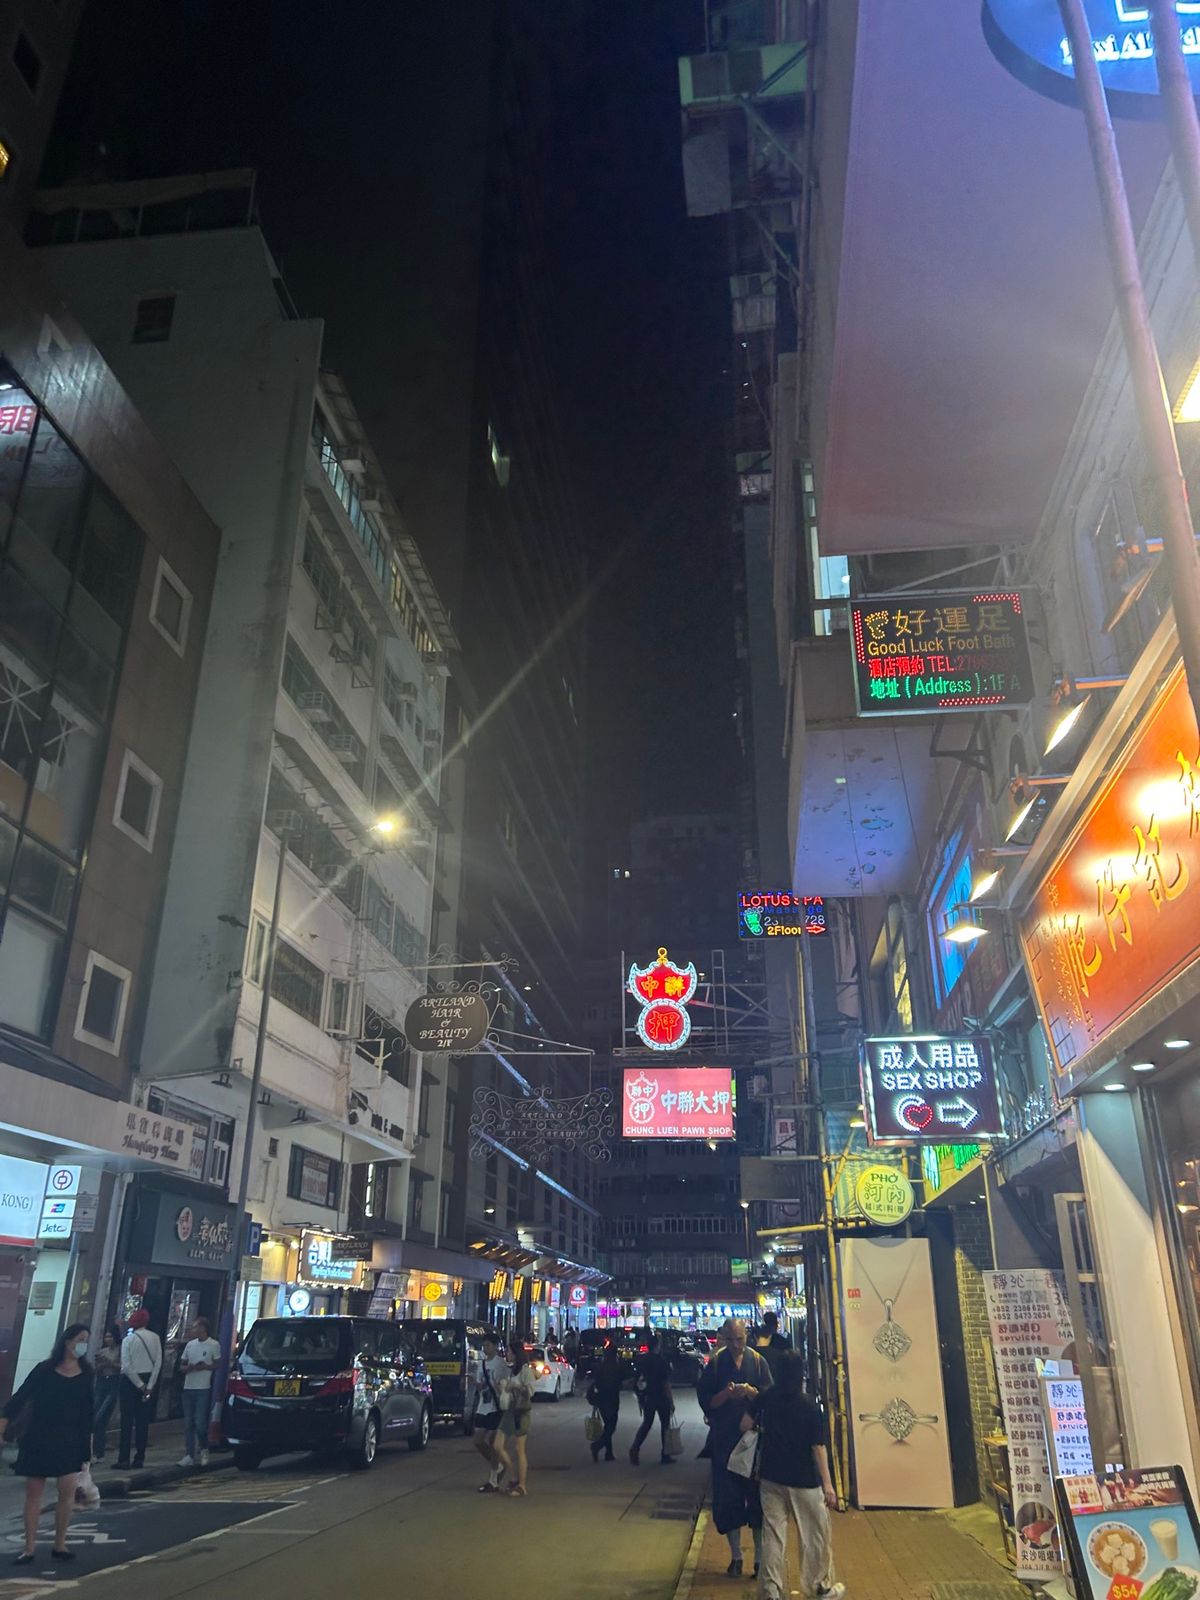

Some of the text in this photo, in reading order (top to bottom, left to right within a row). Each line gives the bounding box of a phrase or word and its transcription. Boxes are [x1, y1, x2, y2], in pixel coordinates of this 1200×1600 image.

[868, 639, 906, 656] Good
[910, 638, 944, 653] Luck
[948, 636, 979, 650] Foot
[870, 678, 900, 699] 地址
[742, 894, 790, 906] LOTUS
[765, 906, 822, 915] Massge
[419, 996, 475, 1008] ARTLAND
[431, 1008, 463, 1018] HAIR
[441, 1018, 451, 1027] &
[649, 1010, 680, 1042] 押
[419, 1027, 472, 1039] BEAUTY
[879, 1043, 979, 1070] 成人用品
[881, 1071, 983, 1090] SEX SHOP
[660, 1089, 730, 1115] 中聯大押
[625, 1126, 731, 1135] CHUNG LUEN PAWN SHOP
[2, 1193, 34, 1213] KONG)
[1111, 1584, 1138, 1598] $54
